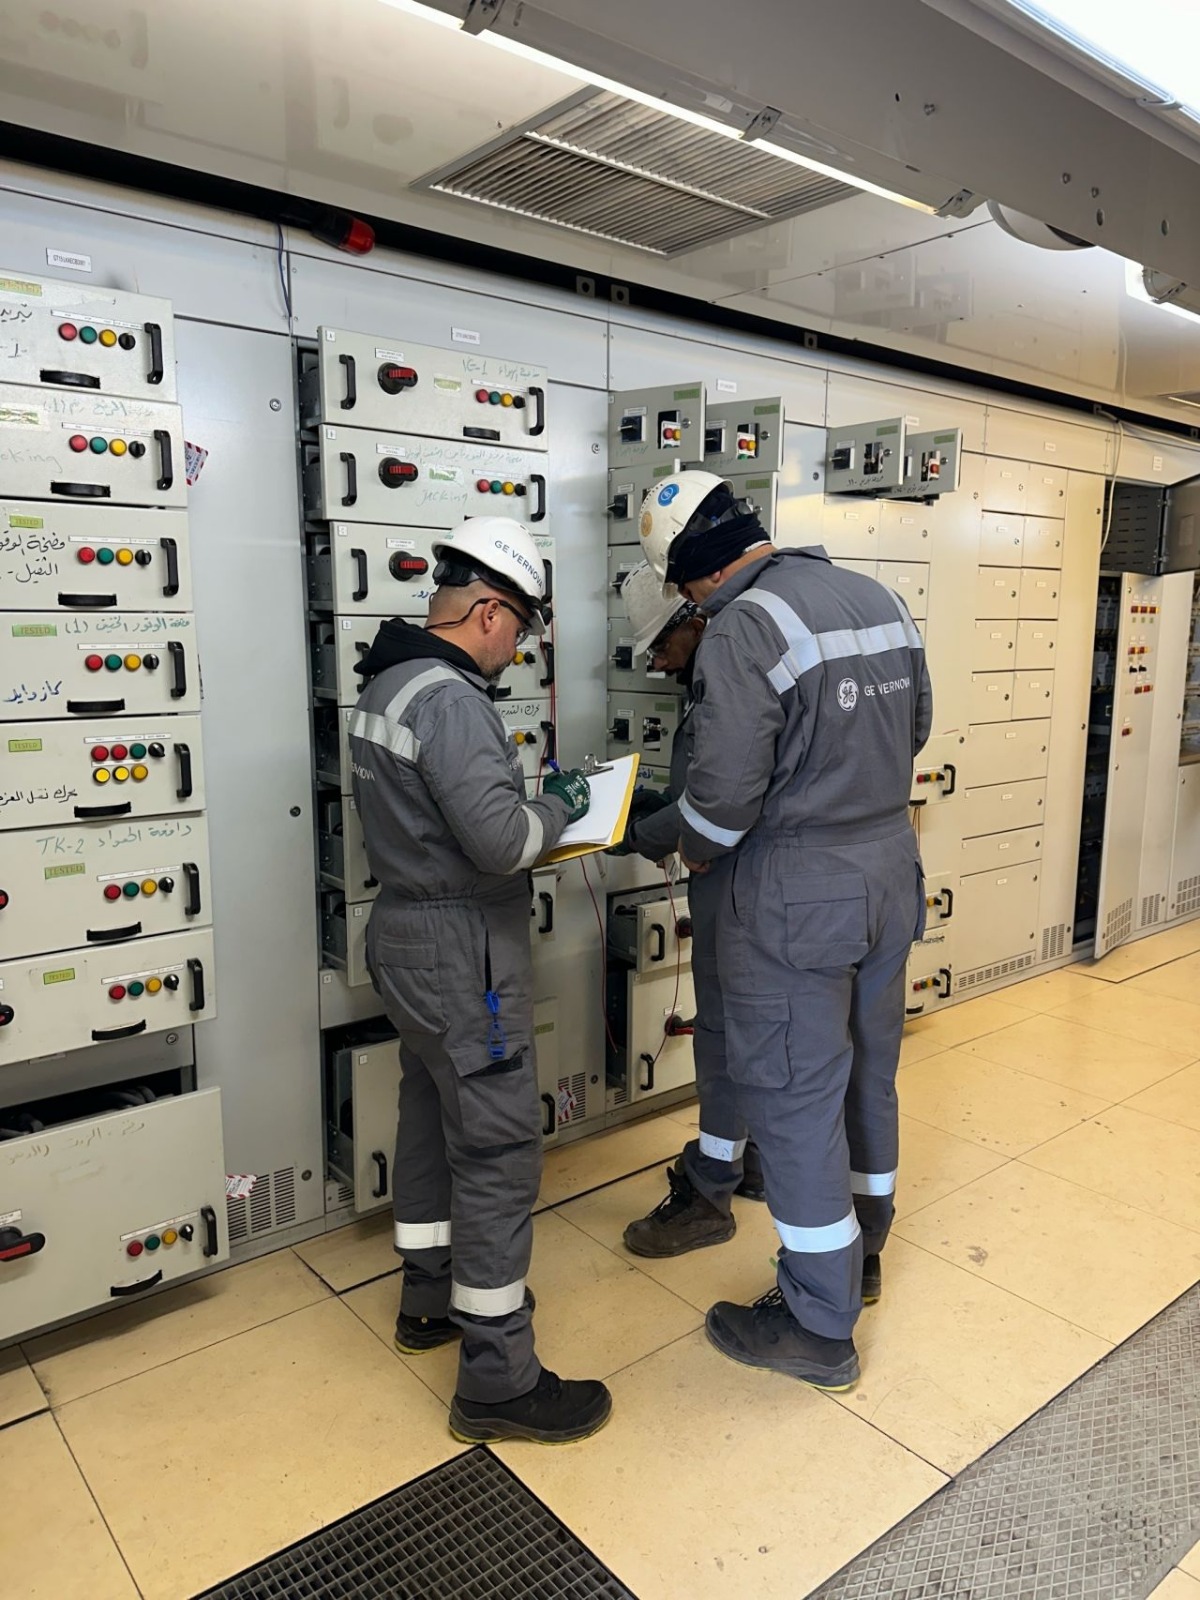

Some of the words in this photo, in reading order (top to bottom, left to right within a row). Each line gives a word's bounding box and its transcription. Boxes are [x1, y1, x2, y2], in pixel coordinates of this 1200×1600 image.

[494, 540, 510, 553] GE
[512, 549, 543, 588] VERNOVA
[19, 626, 51, 636] TESTED
[864, 685, 876, 696] GE
[877, 677, 911, 695] VERNOVA
[36, 836, 85, 856] TK-2
[48, 863, 84, 876] TESTED
